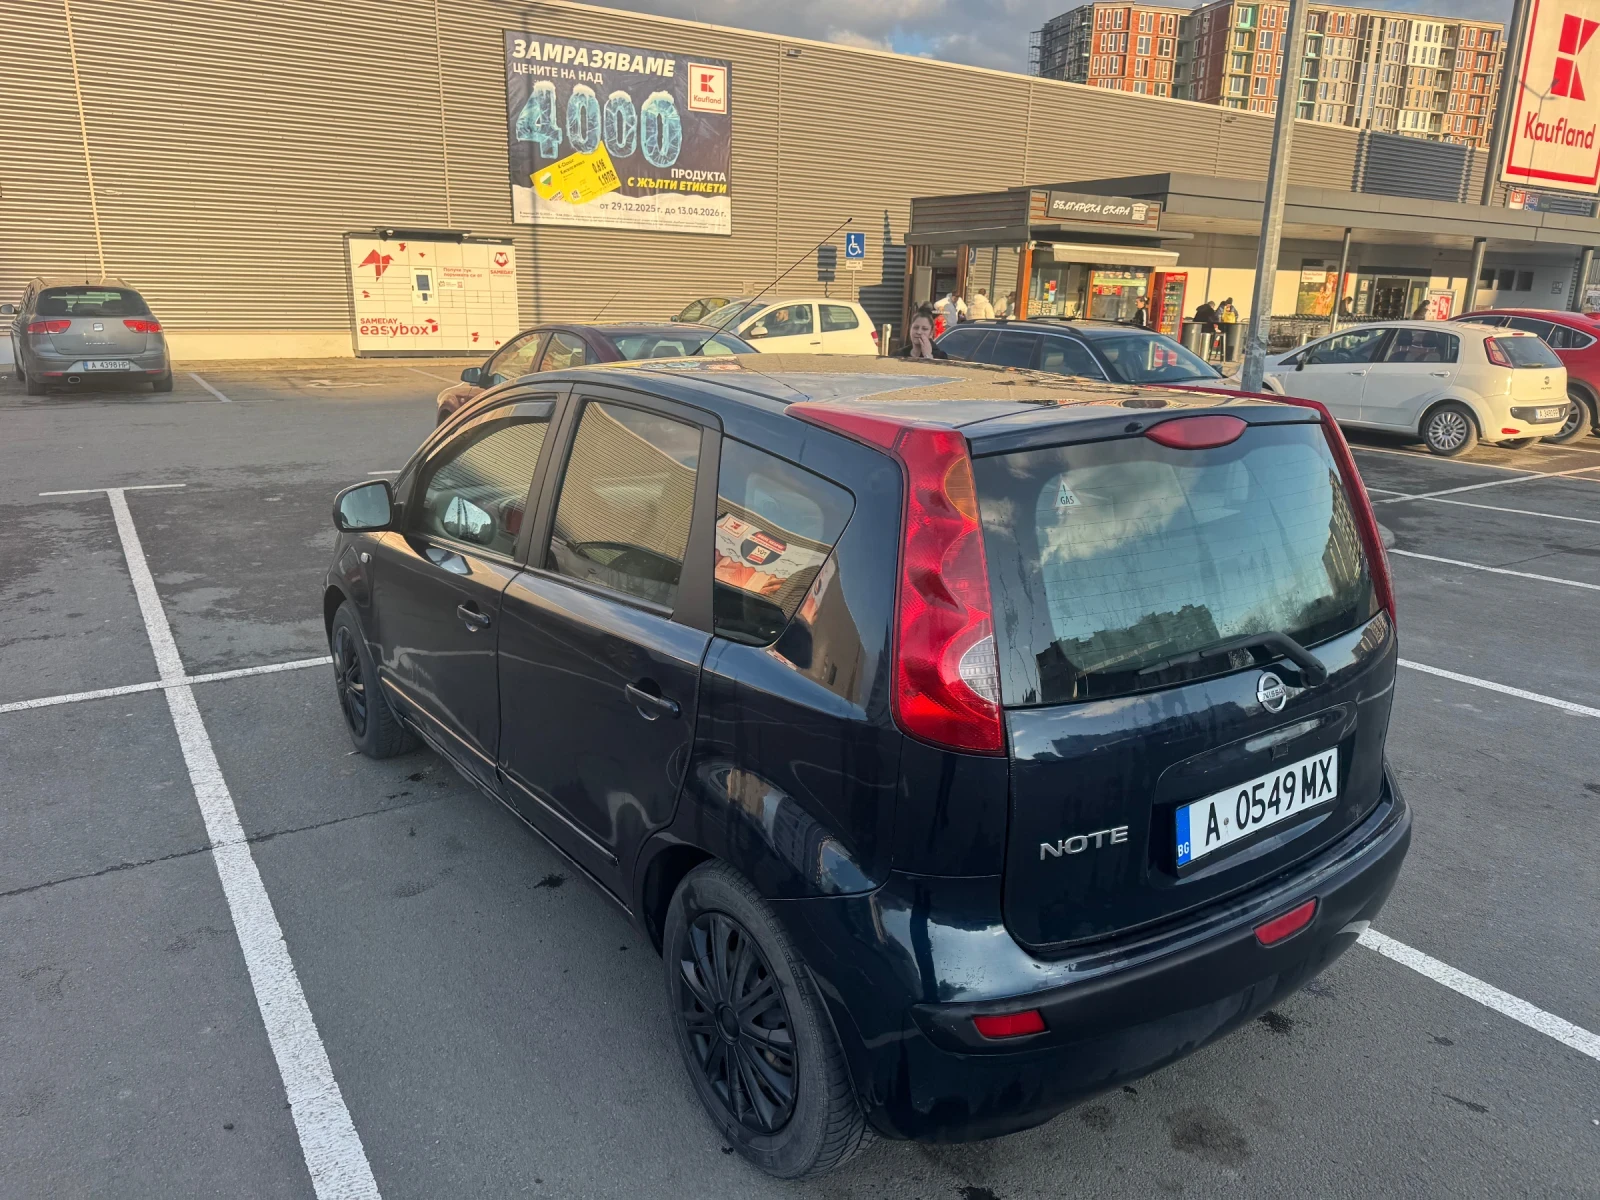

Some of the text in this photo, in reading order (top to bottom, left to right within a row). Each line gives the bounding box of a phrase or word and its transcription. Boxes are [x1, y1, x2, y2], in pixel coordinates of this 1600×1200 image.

[512, 39, 676, 77] ЗАМРАЗЯВАМЕ
[513, 62, 603, 84] ЦЕНИТЕ НА НАД
[693, 94, 722, 106] Kaufland
[516, 80, 683, 168] 4000
[1523, 111, 1597, 149] Kaufland
[671, 168, 727, 182] ПРОДУКТА
[627, 178, 727, 193] С ЖЪЛТИ ЕТИКЕТИ
[611, 202, 656, 213] 29.12.2025
[664, 206, 676, 216] до
[677, 207, 720, 217] 13.04.2026
[1053, 200, 1131, 216] БЪЛГАРСКА СКАРА
[360, 317, 398, 325] SAMEDAY
[360, 322, 429, 338] easybox
[1060, 495, 1075, 505] GAS
[1039, 825, 1129, 861] NOTE
[1177, 841, 1190, 858] BG
